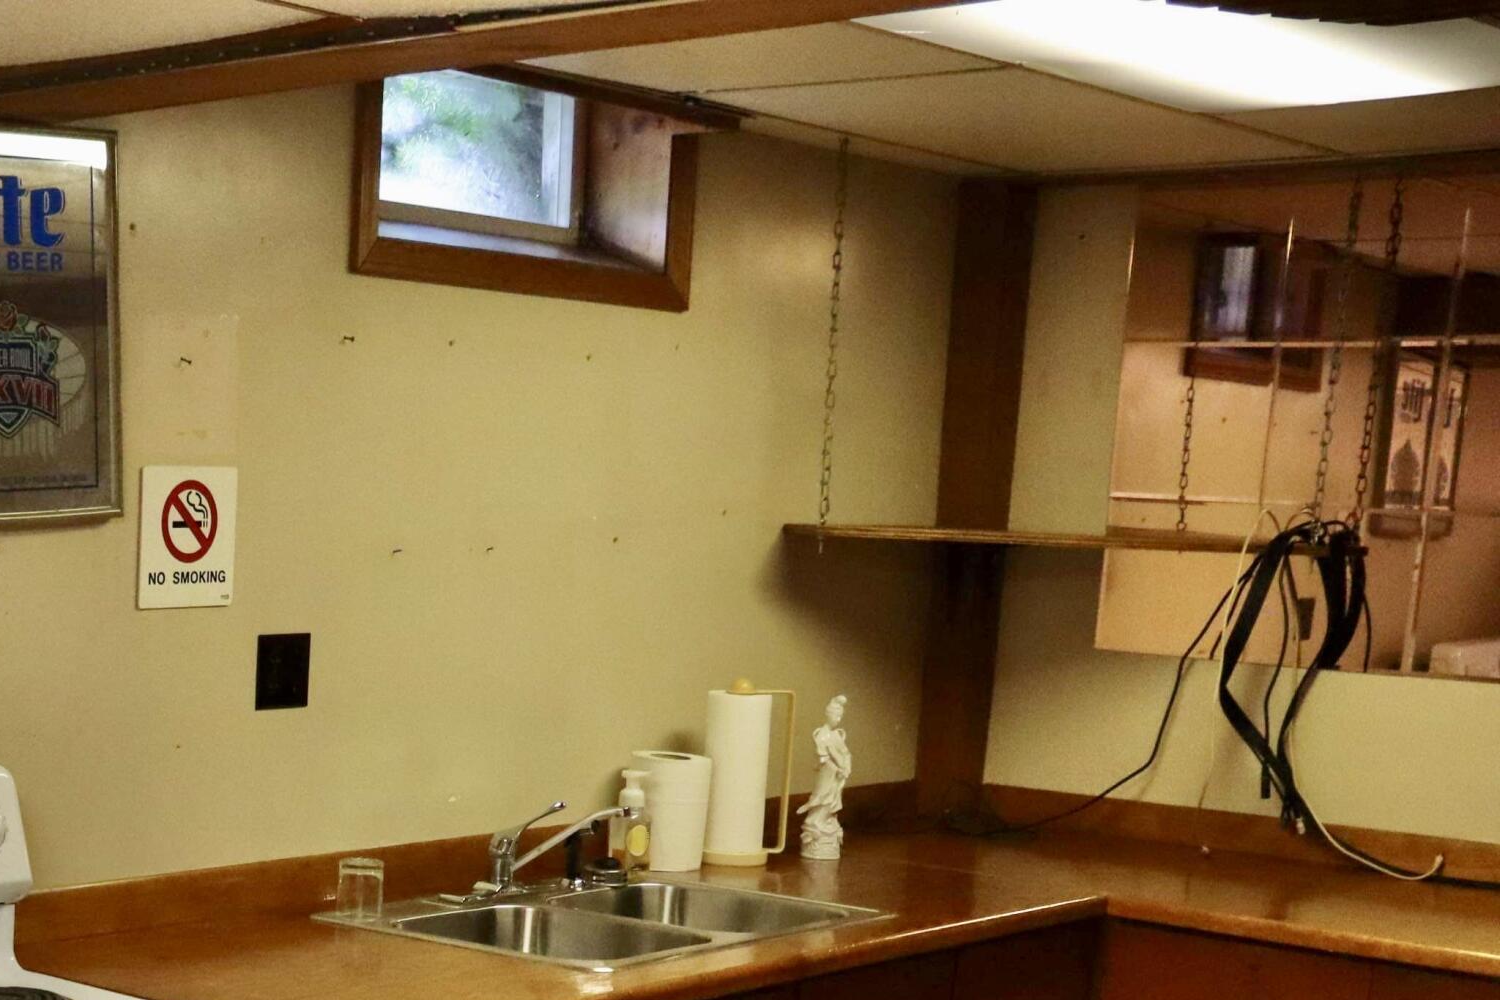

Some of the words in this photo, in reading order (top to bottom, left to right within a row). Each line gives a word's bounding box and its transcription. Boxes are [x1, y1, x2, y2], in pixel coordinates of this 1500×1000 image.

[7, 251, 63, 272] BEER
[148, 571, 166, 586] NO
[172, 570, 226, 585] SMOKING
